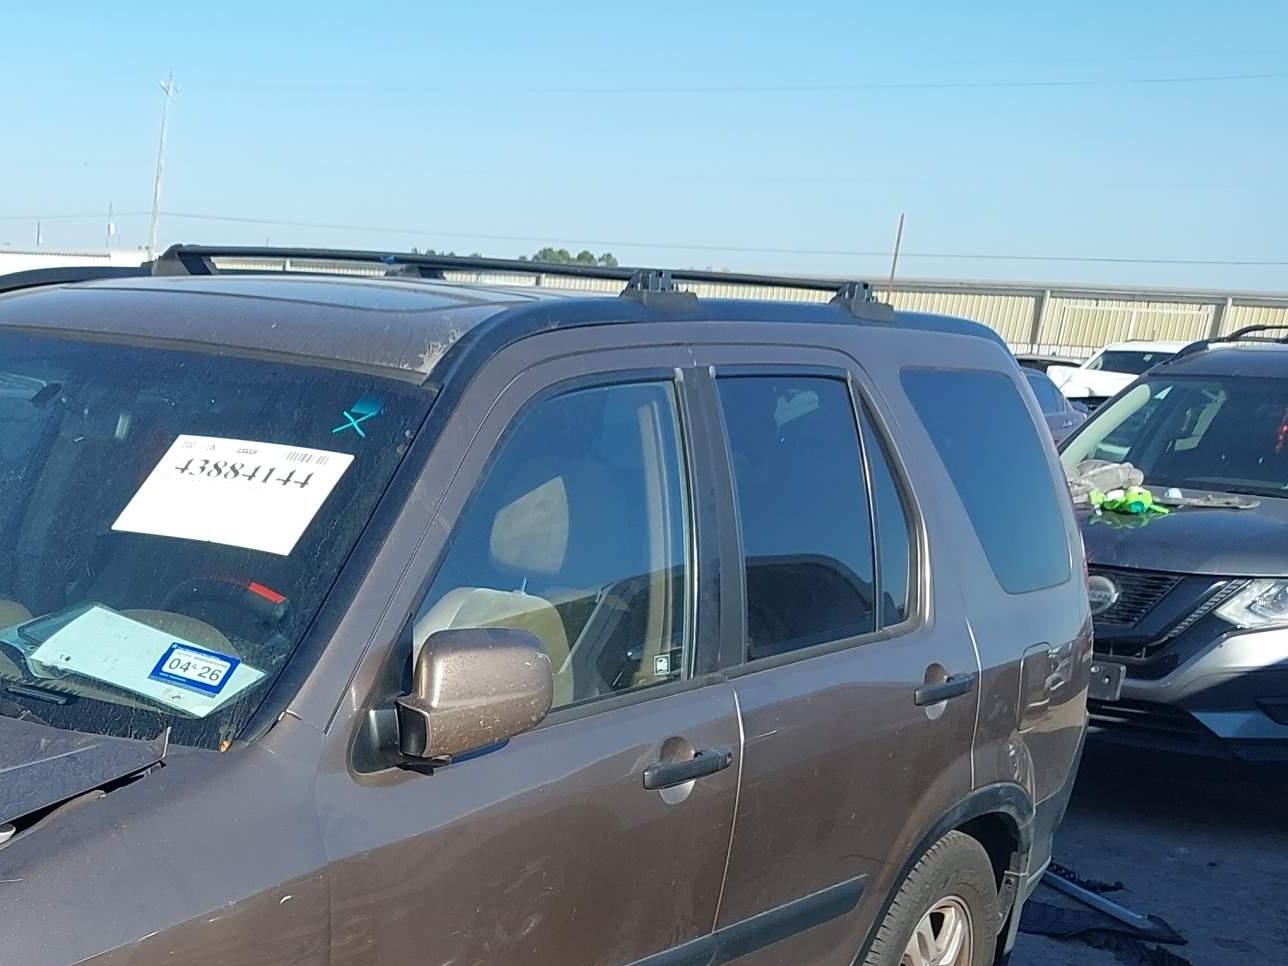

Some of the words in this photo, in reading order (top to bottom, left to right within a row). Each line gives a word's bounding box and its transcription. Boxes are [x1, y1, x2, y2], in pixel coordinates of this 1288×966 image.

[175, 458, 314, 488] 43884144
[168, 658, 192, 672] 04
[198, 666, 222, 681] 26
